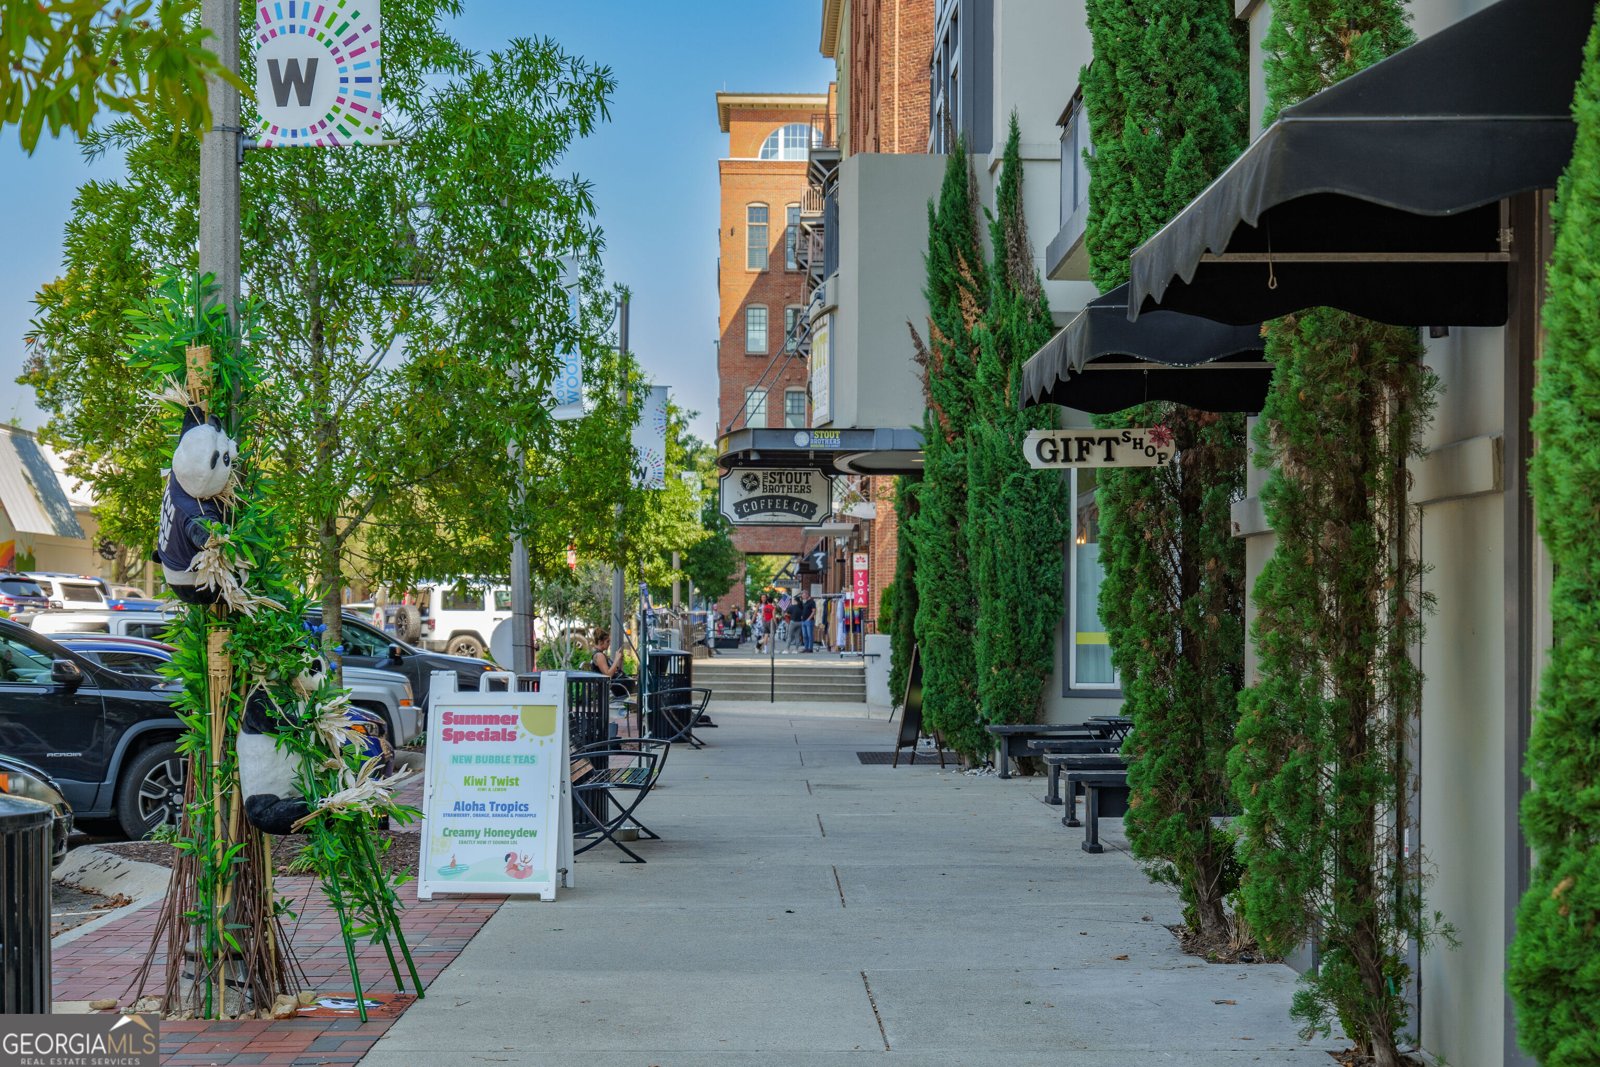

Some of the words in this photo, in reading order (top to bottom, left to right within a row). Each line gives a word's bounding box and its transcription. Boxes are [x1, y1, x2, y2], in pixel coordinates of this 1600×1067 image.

[267, 58, 319, 107] W
[814, 430, 841, 439] STOUT
[1035, 436, 1120, 464] GIFT
[1121, 430, 1168, 465] SHOP
[768, 471, 812, 484] STOUT
[762, 484, 812, 494] BROTHERS
[742, 499, 789, 514] COFFEE
[792, 501, 809, 514] CO
[442, 711, 519, 726] Summer
[442, 728, 517, 744] Specials
[452, 754, 473, 764] NEW
[475, 754, 511, 764] BUBBLE
[513, 754, 536, 764] TEAS
[463, 775, 487, 786] Kiwi
[490, 775, 520, 786] Twist
[453, 800, 486, 812] Aloha
[489, 800, 529, 814] Tropics
[442, 827, 481, 840] Creamy
[483, 827, 538, 840] Honeydew
